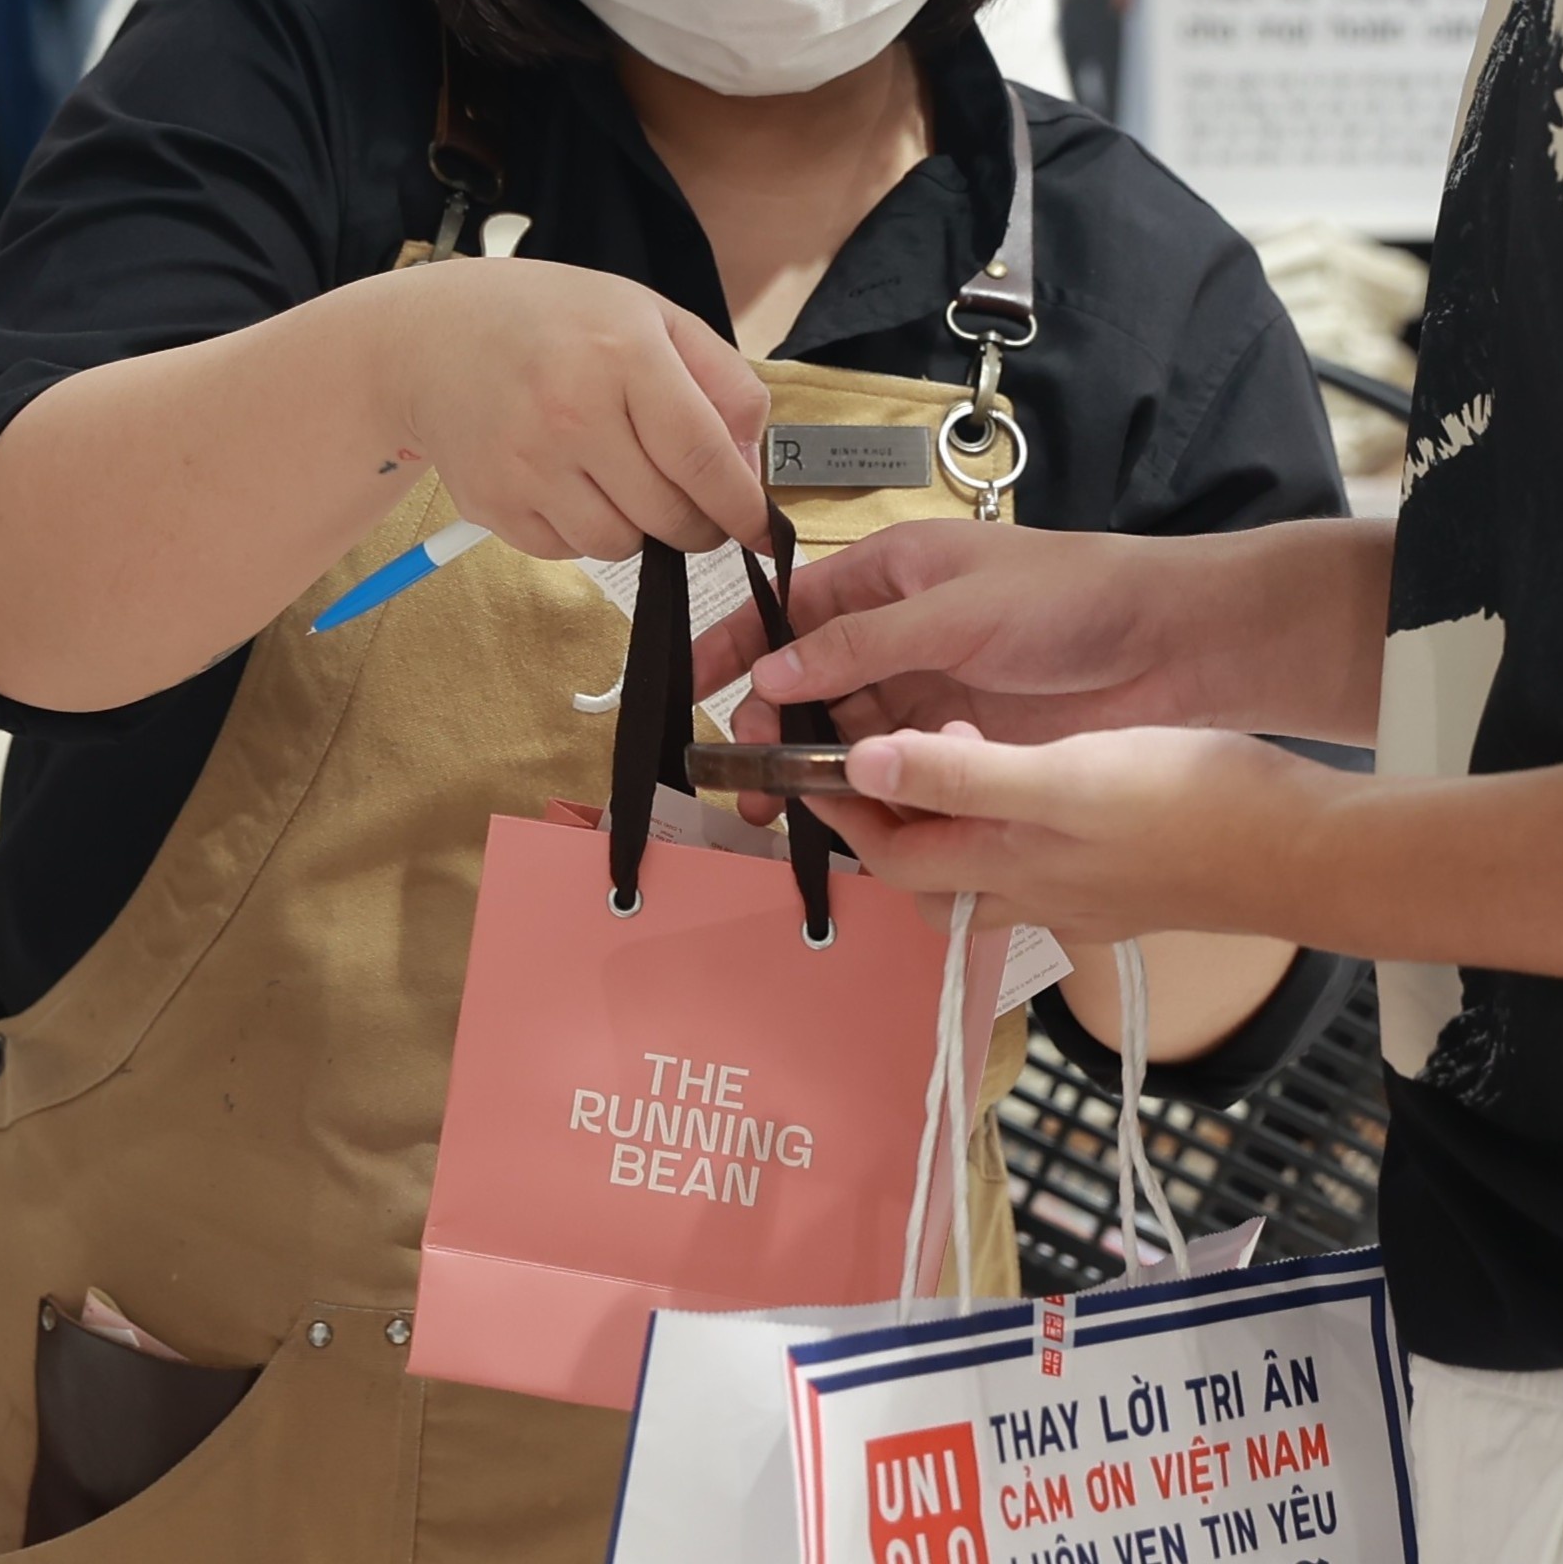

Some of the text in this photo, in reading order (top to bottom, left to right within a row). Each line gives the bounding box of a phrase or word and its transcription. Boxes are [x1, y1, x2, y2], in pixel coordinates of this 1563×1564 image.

[644, 1052, 750, 1110] THE
[569, 1088, 814, 1169] RUNNING
[609, 1142, 760, 1207] BEAN
[989, 1349, 1320, 1464] THAY LỜI TRI ÂN
[876, 1449, 962, 1523] UNI
[1000, 1423, 1331, 1531] CẢM ƠN VIỆT NAM
[1200, 1509, 1259, 1559] TIN
[1268, 1484, 1337, 1545] YÊU
